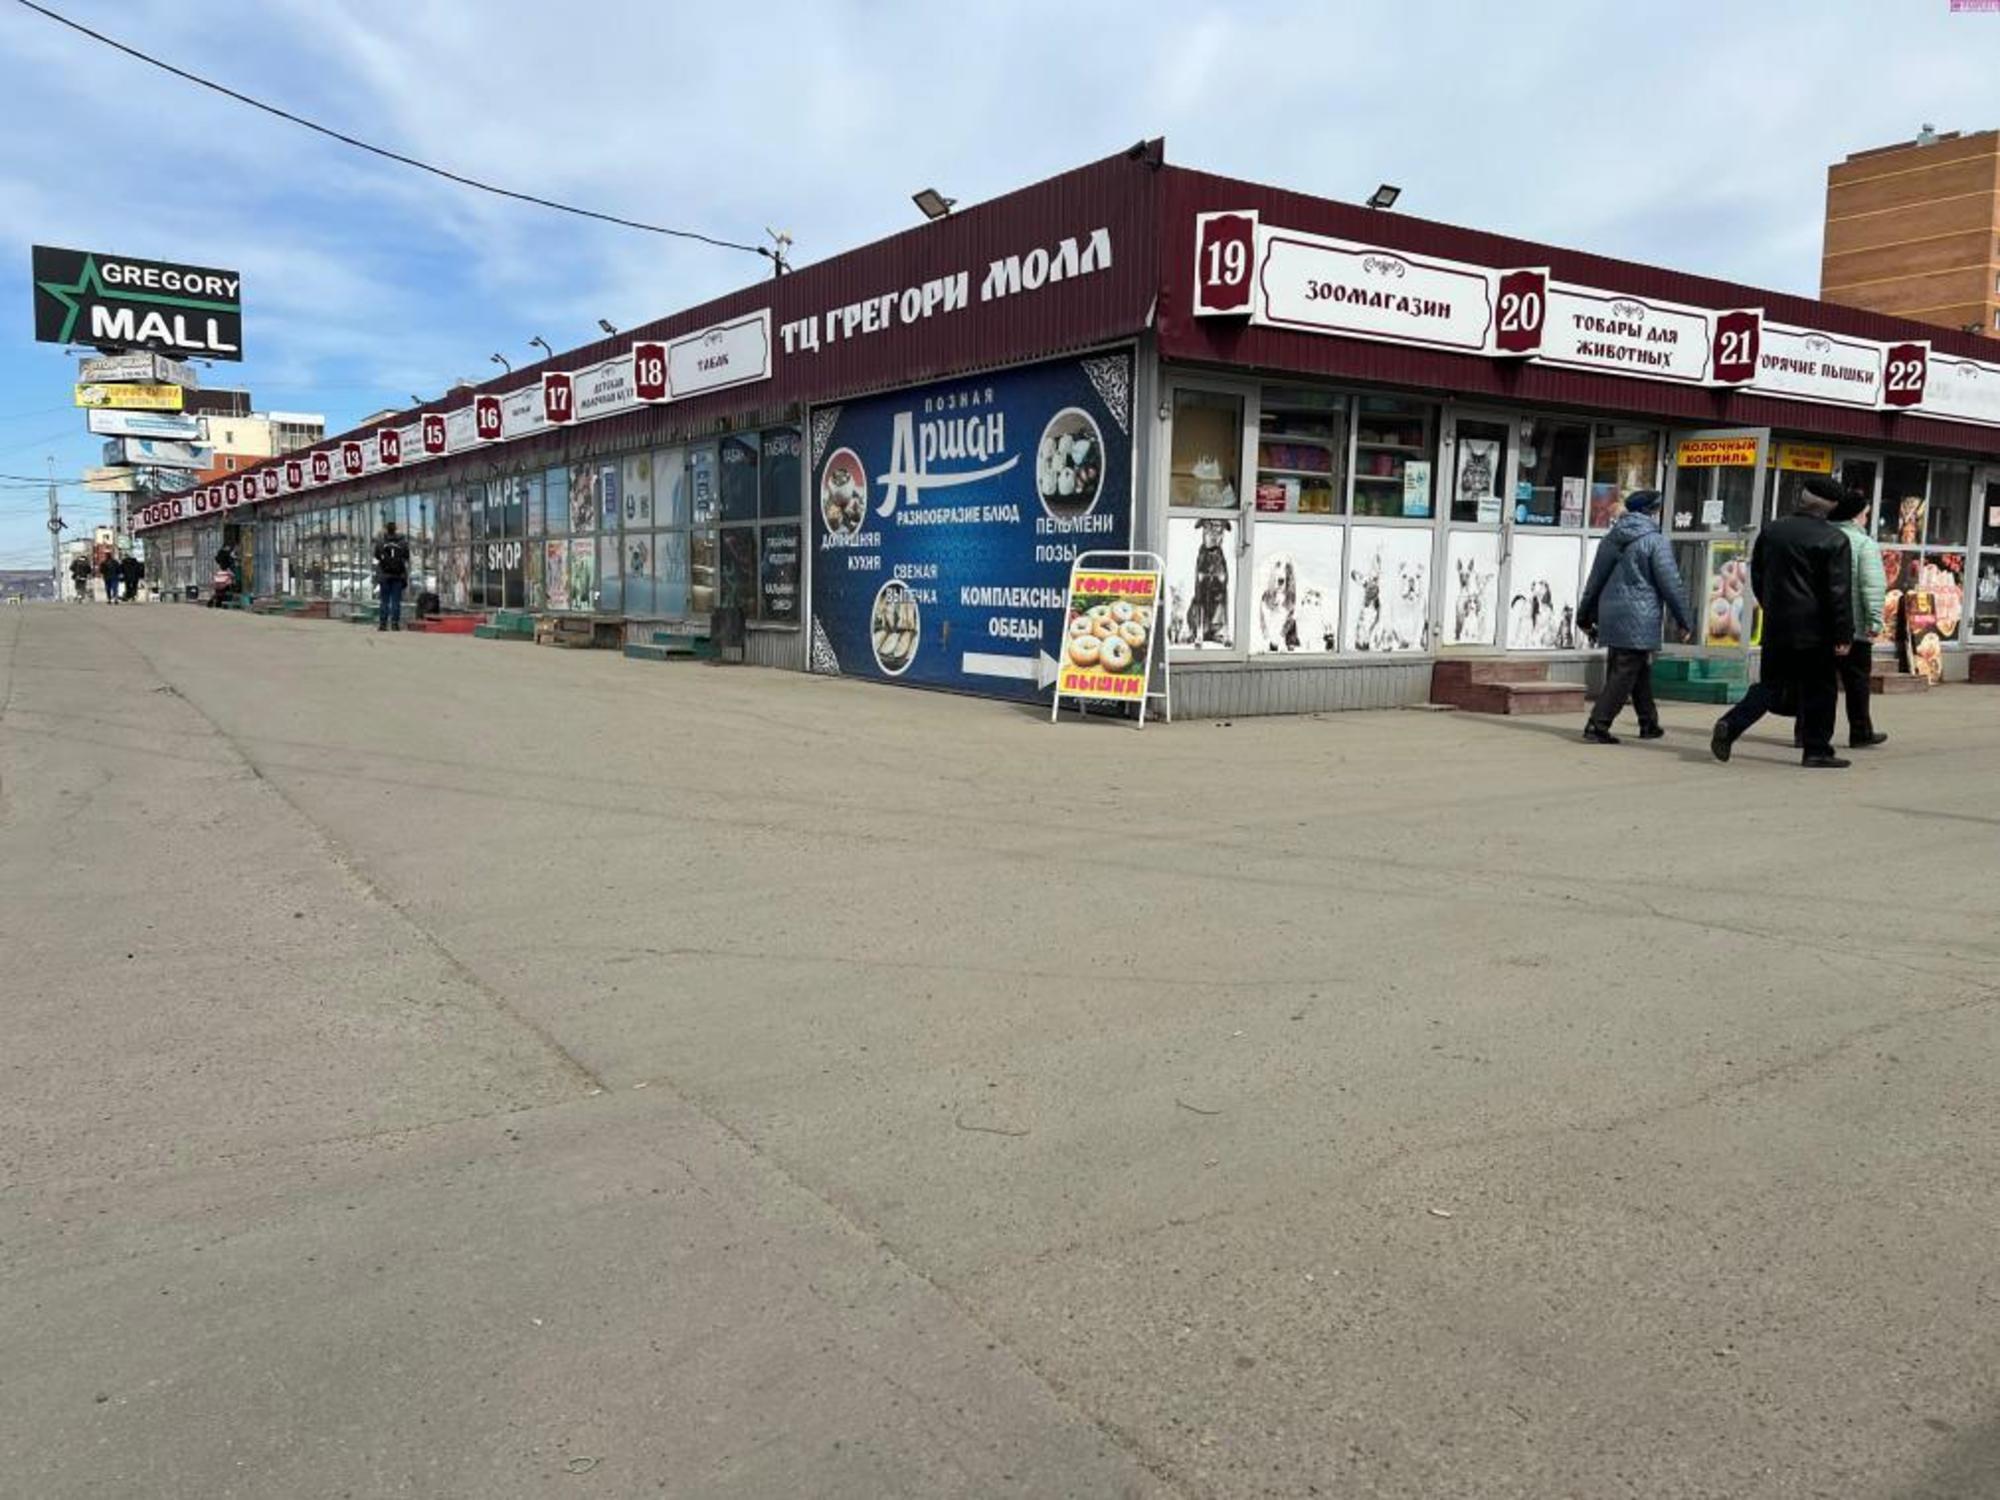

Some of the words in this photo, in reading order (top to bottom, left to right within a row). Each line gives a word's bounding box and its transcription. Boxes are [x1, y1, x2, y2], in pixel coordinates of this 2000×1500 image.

[1207, 239, 1246, 286] 19
[102, 263, 239, 298] GREGORY
[780, 316, 820, 354] ТЦ
[826, 270, 969, 344] ГРЕГОРИ
[981, 227, 1112, 302] МОЛЛ
[1305, 280, 1451, 319] ЗООМАГАЗИН
[1500, 292, 1540, 332] 20
[91, 305, 238, 351] MALL
[1572, 314, 1642, 338] ТОВАРЫ
[1646, 327, 1679, 345] ДЛЯ
[1576, 339, 1674, 369] ЖИВОТНЫХ
[1720, 330, 1751, 365] 21
[638, 358, 663, 386] 18
[1821, 360, 1875, 384] ПЫШКИ
[1888, 360, 1922, 391] 22
[548, 387, 569, 411] 17
[925, 387, 994, 413] ПОЗНАЯ
[479, 407, 499, 429] 16
[426, 425, 443, 444] 15
[1681, 437, 1757, 452] МОЛОЧНЫЙ
[346, 451, 360, 468] 13
[381, 439, 397, 457] 14
[314, 461, 328, 476] 12
[875, 411, 1021, 518] Аршан
[486, 476, 521, 508] VAPE
[896, 505, 980, 526] РАЗНООБРАЗИЕ
[982, 503, 1020, 524] БЛЮД
[1036, 513, 1114, 535] ПЕЛЬМЕНИ
[822, 532, 882, 549] ДОМАШНЯЯ
[488, 541, 521, 571] SHOP
[848, 555, 882, 571] КУХНЯ
[1036, 544, 1077, 563] ПОЗЫ
[893, 563, 939, 580] СВЕЖАЯ
[886, 587, 938, 605] ВЫПЕЧКА
[960, 586, 1068, 609] КОМПЛЕКСНЫ
[1075, 576, 1155, 595] ГОРЯЧИЕ
[988, 617, 1044, 641] ОБЕДЫ
[1065, 673, 1141, 695] ПЫШКИ
